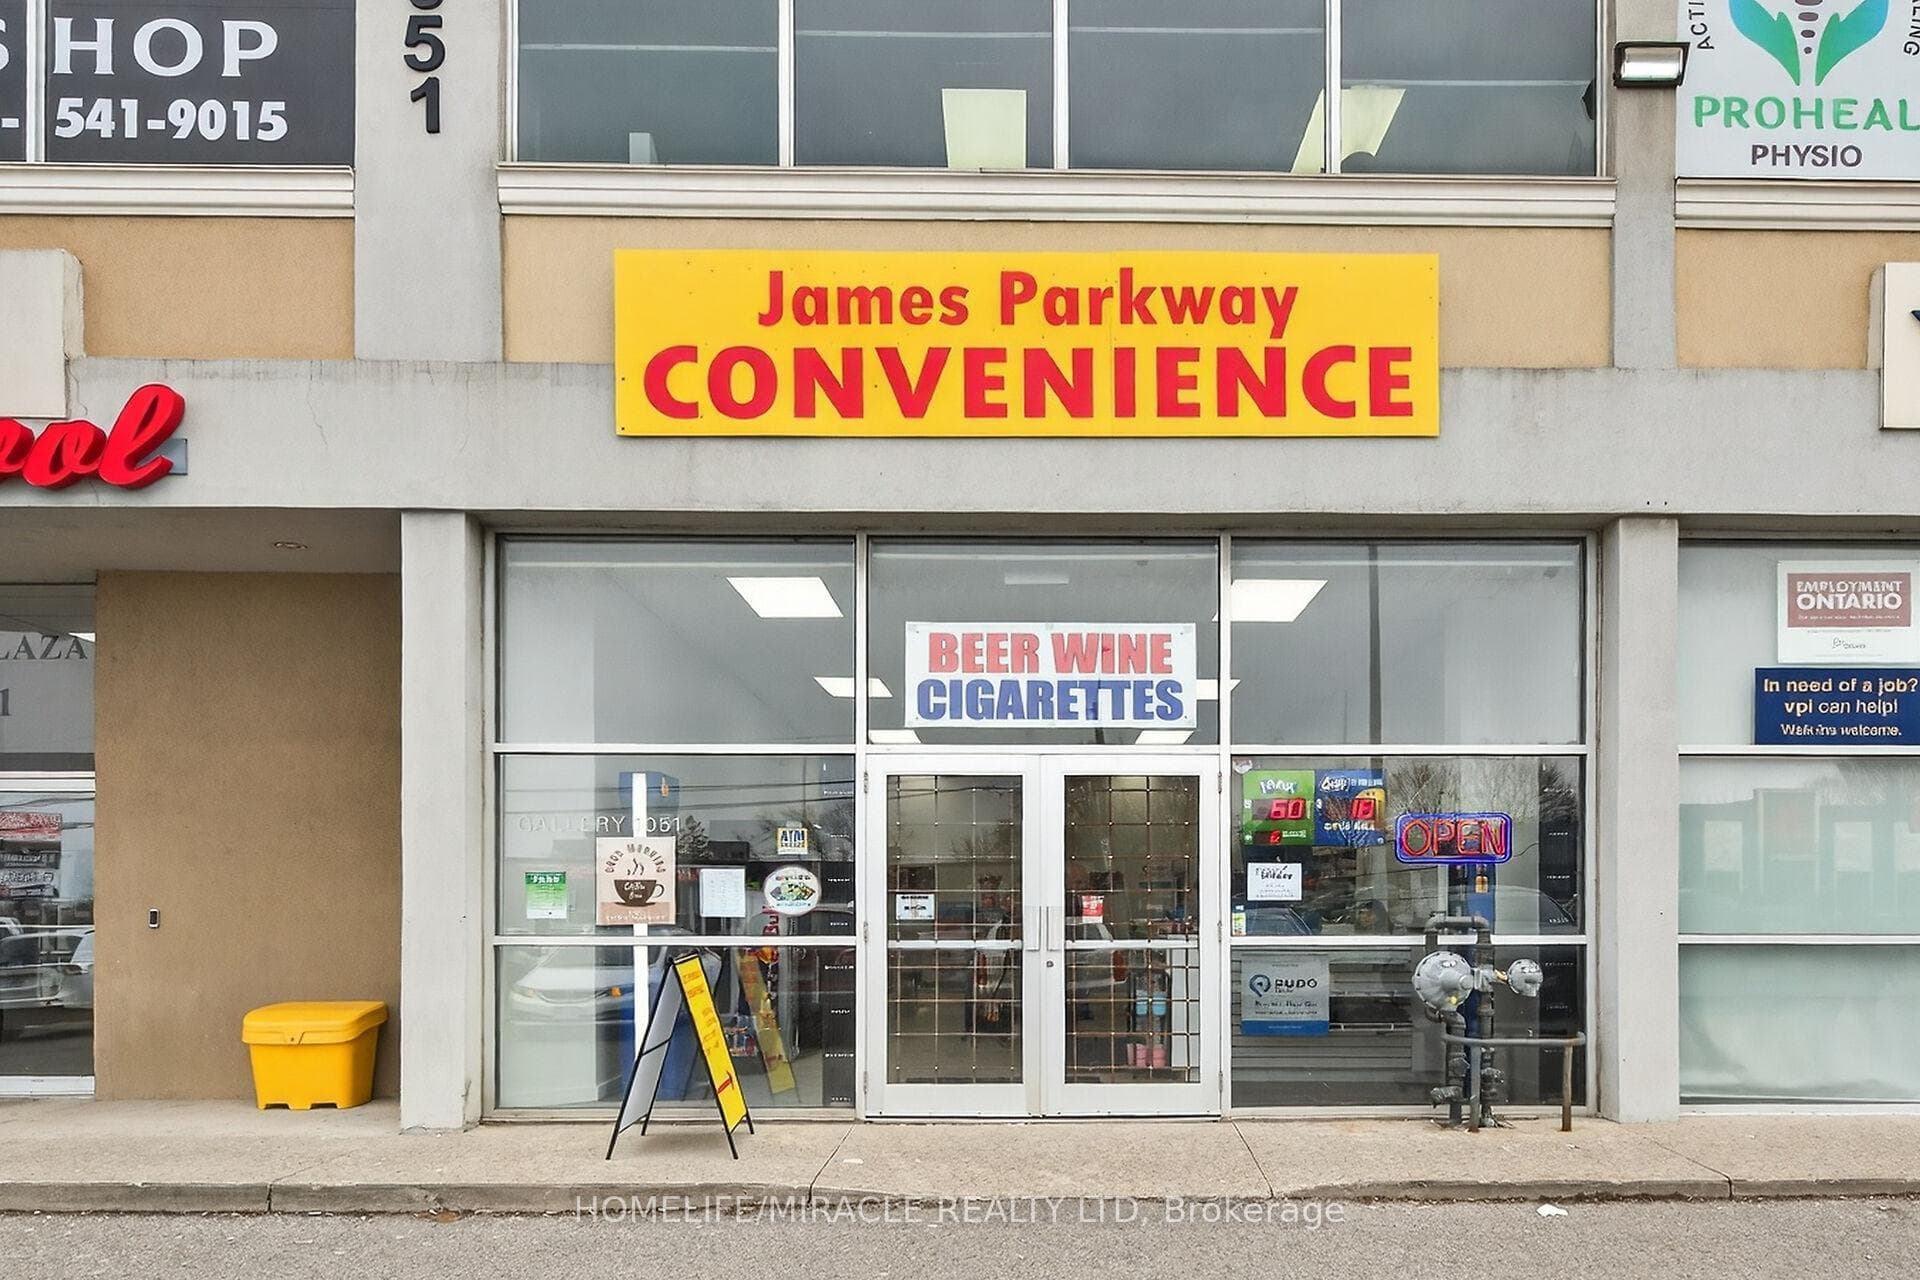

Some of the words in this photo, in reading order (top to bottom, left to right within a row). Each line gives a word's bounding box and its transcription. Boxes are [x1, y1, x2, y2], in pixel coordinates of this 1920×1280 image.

[0, 17, 278, 77] HOP
[403, 0, 446, 134] 51
[1751, 145, 1863, 168] PHYSIO
[758, 270, 969, 327] James
[1000, 269, 1299, 338] Parkway
[643, 345, 1414, 419] CONVENIENCE
[1796, 581, 1903, 593] EMPLOYMENT
[1796, 592, 1903, 610] ONTARIO
[928, 632, 1041, 673] BEER
[1051, 632, 1173, 674] WINE
[916, 678, 1184, 721] CIGARETTES
[1763, 679, 1780, 692] In
[1786, 678, 1833, 693] need
[1838, 678, 1858, 693] of
[1862, 681, 1873, 693] a
[1878, 677, 1919, 697] job?
[1818, 702, 1850, 714] can
[1856, 698, 1898, 717] help!
[633, 815, 680, 833] 051
[1401, 819, 1507, 857] OPEN
